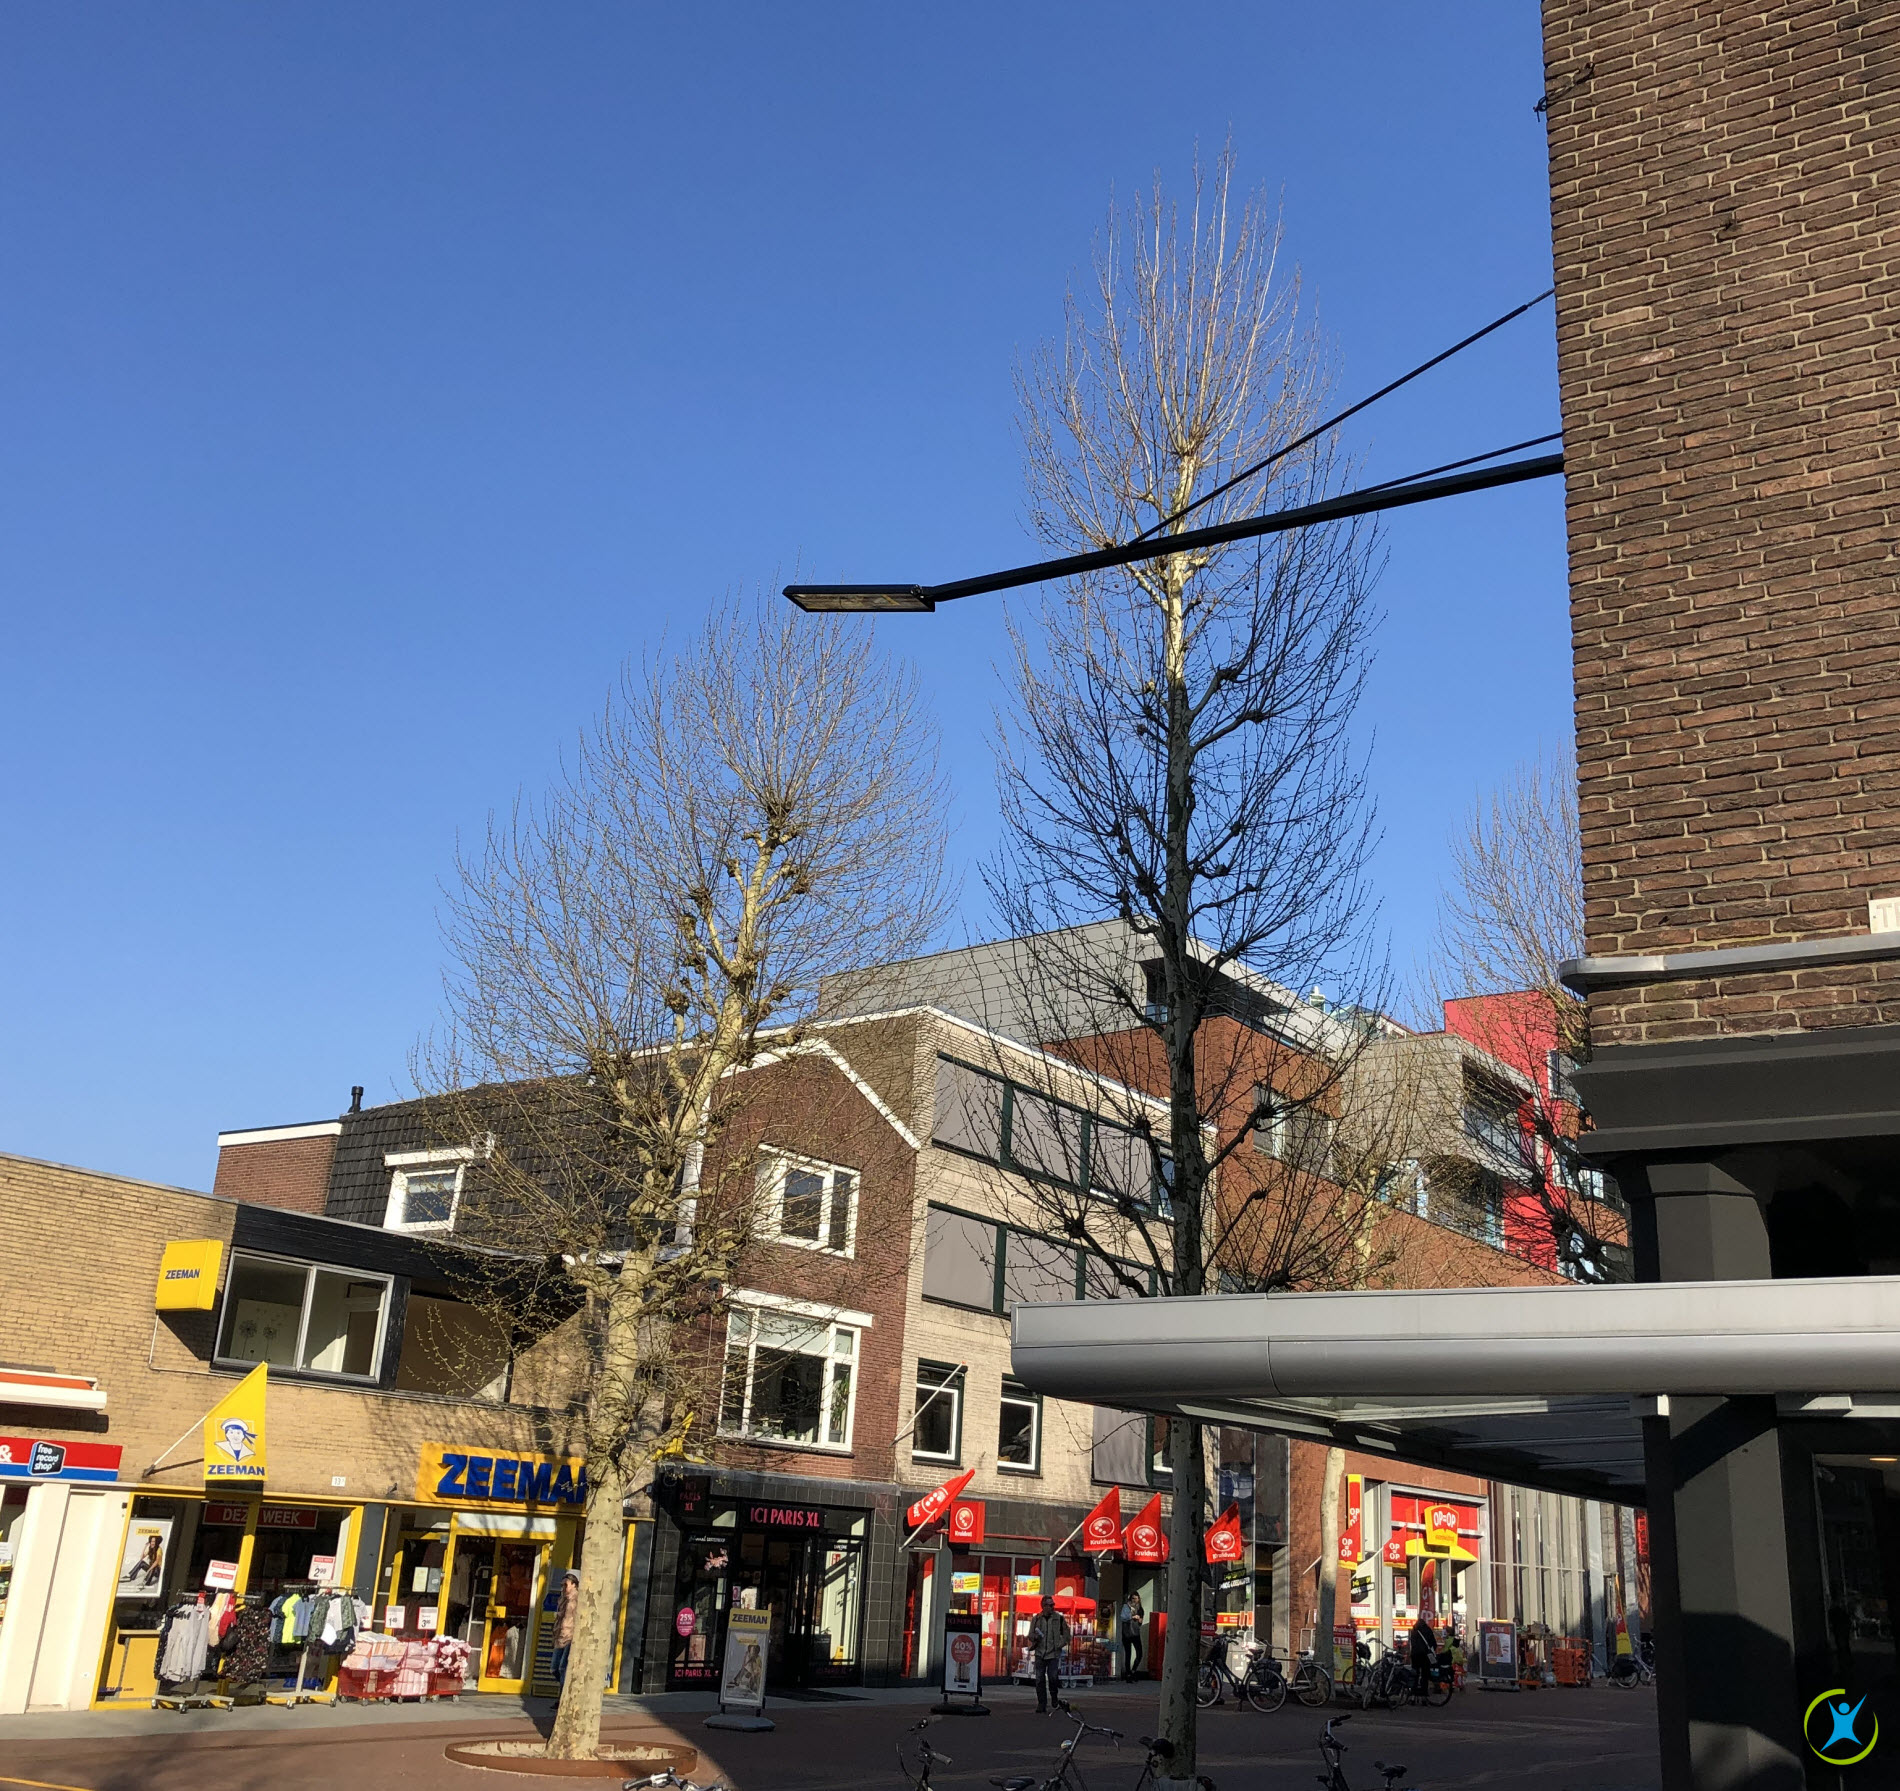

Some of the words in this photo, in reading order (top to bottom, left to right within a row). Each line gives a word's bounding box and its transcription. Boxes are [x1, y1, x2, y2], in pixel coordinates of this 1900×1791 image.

[165, 1268, 200, 1280] ZEEMAN
[0, 1444, 13, 1463] &
[37, 1444, 53, 1454] free
[36, 1453, 59, 1462] record
[207, 1464, 265, 1476] ZEEMAN
[222, 1508, 248, 1521] DEZ
[263, 1510, 301, 1524] WEEK
[750, 1507, 768, 1524] ICI
[770, 1508, 804, 1526] PARIS
[806, 1511, 820, 1527] XL
[1350, 1508, 1360, 1516] OP
[1433, 1510, 1456, 1529] OP=OP
[1342, 1537, 1353, 1546] OP
[1341, 1549, 1352, 1558] OP
[680, 1613, 693, 1621] 25%
[732, 1613, 768, 1625] ZEEMAN
[954, 1641, 973, 1650] 40%
[675, 1669, 684, 1677] ICI
[685, 1669, 702, 1678] PARIS
[704, 1669, 712, 1677] XL
[283, 1677, 324, 1689] ZEMAN
